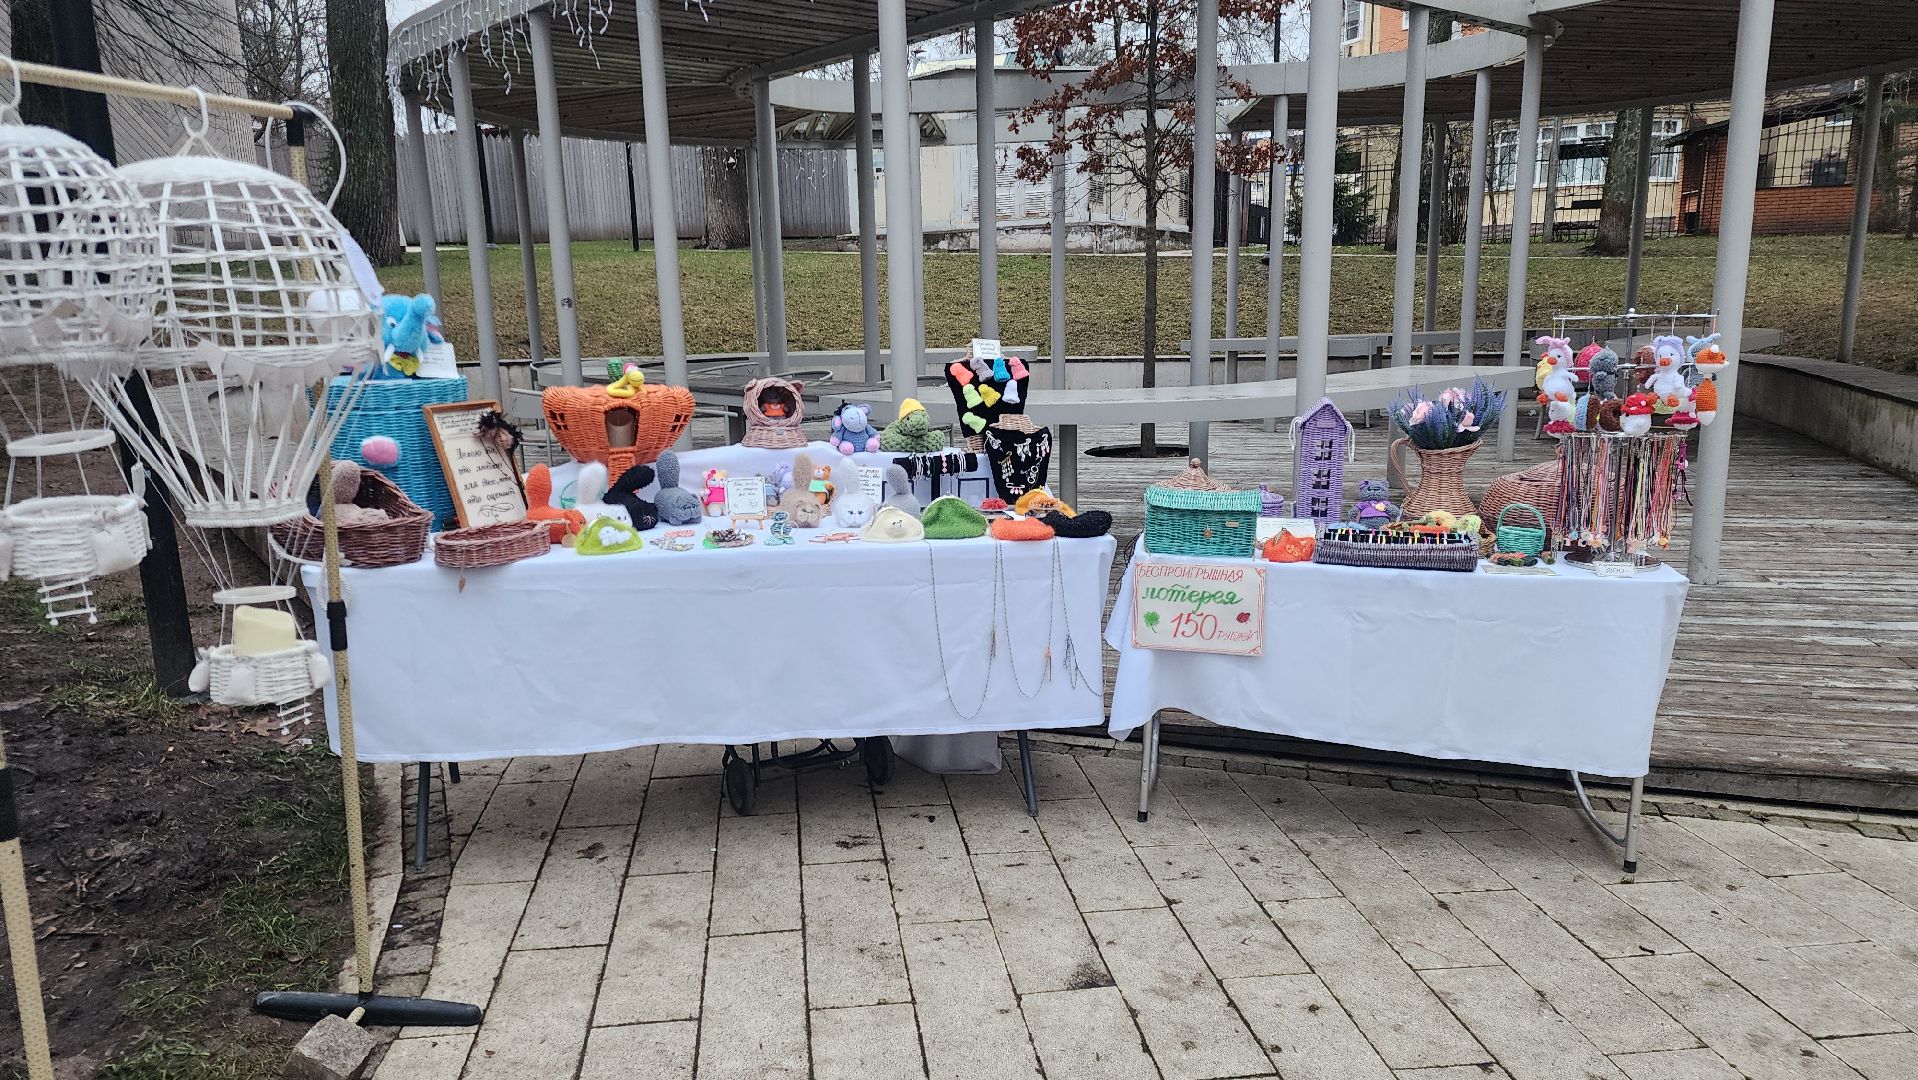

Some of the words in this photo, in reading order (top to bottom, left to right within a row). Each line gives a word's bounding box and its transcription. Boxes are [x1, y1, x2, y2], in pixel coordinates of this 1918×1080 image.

[464, 481, 479, 491] для
[1138, 565, 1244, 583] БЕСПРОИГРЫШНАЯ
[1141, 583, 1244, 614] лотерея
[1170, 612, 1218, 641] 150
